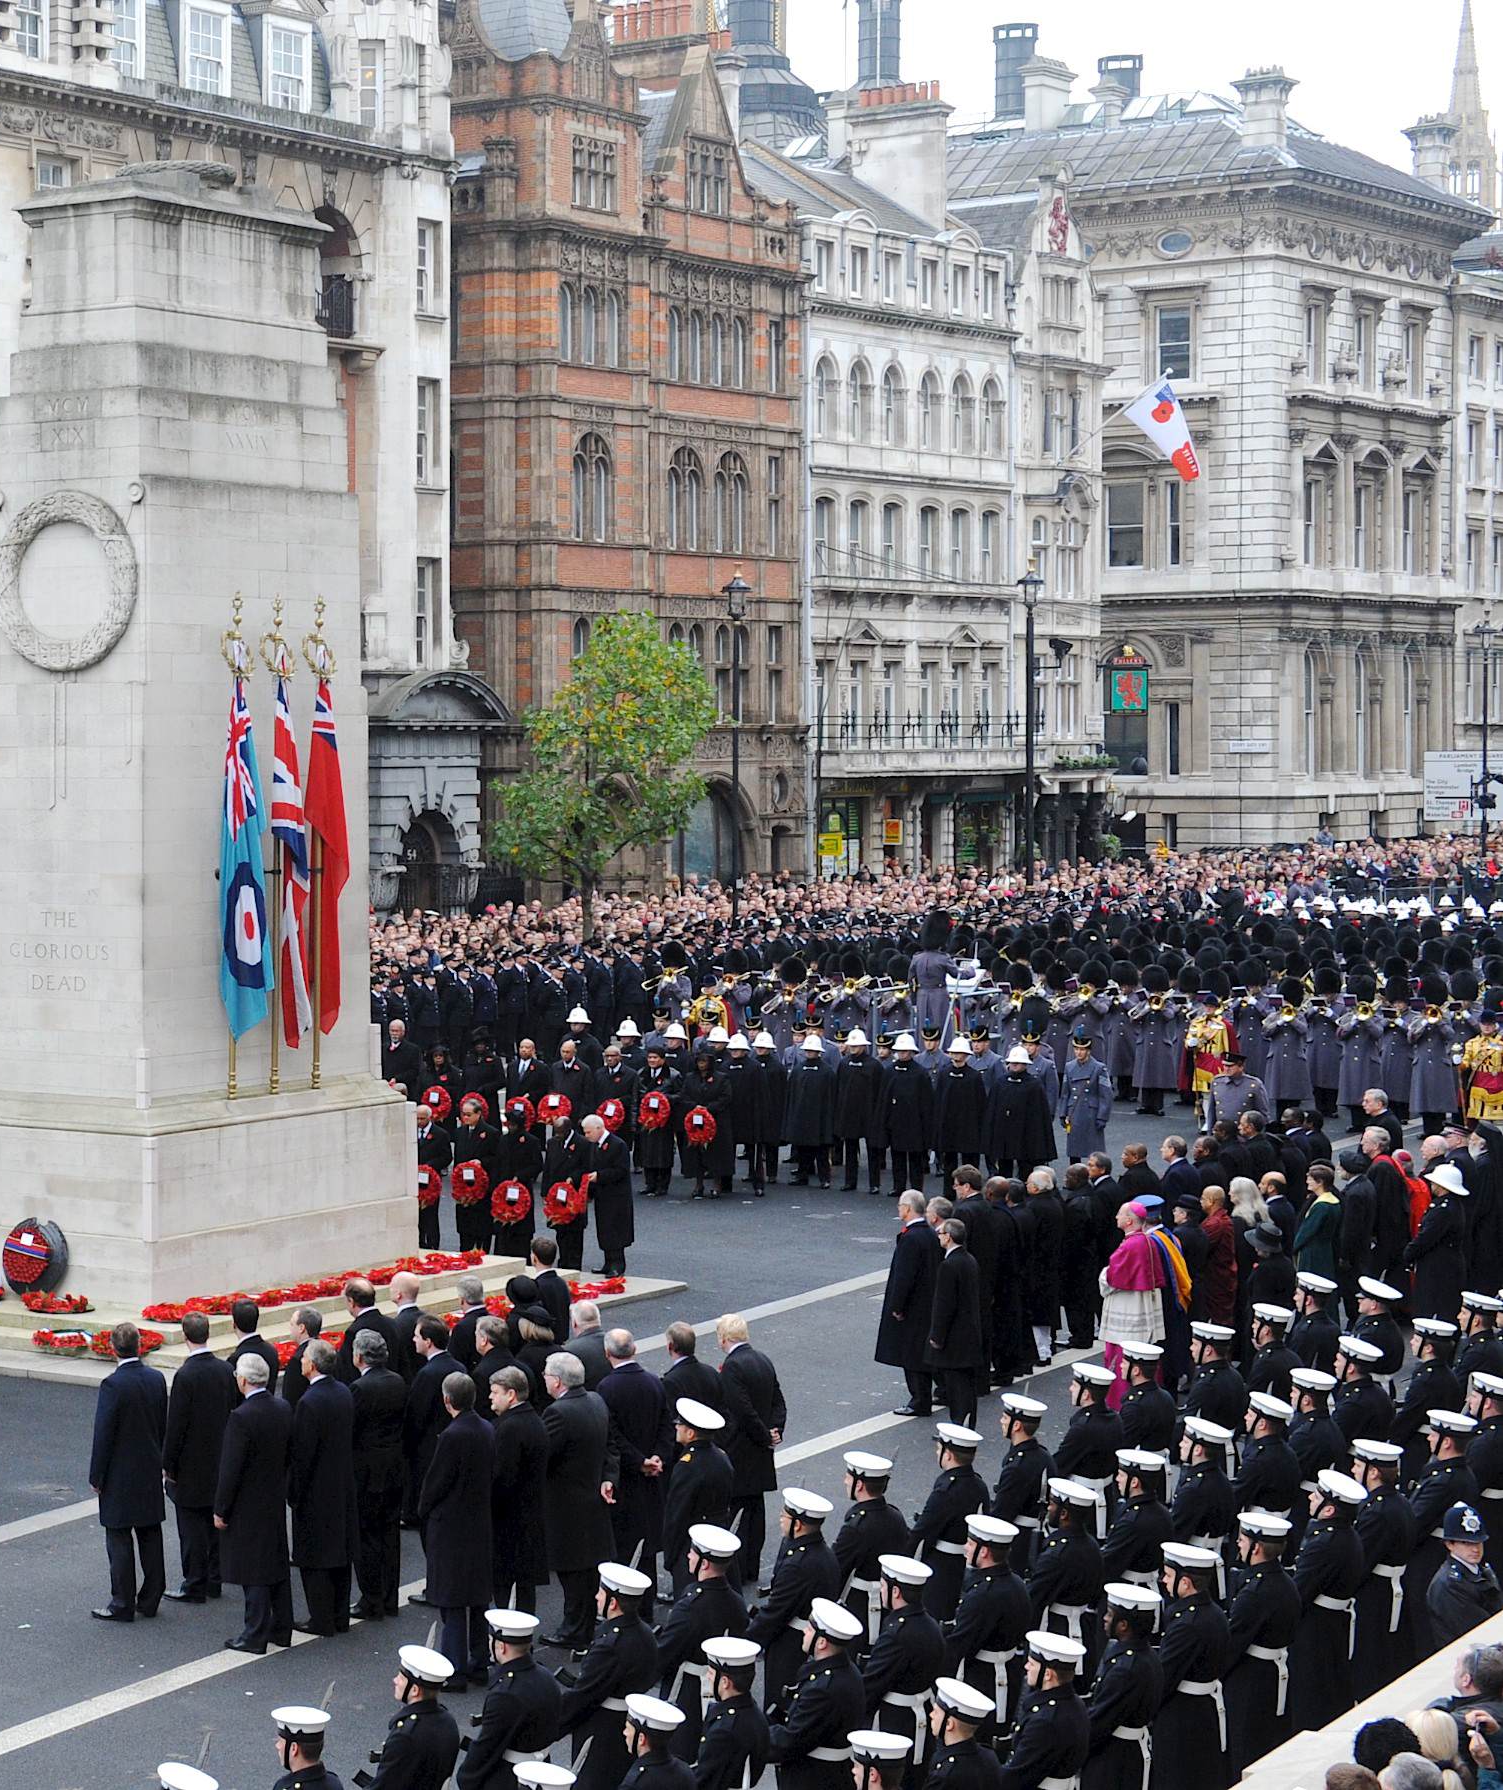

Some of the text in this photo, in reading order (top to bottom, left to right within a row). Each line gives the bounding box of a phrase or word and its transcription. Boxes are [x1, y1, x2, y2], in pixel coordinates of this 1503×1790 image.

[48, 396, 90, 416] MCM
[51, 426, 84, 446] XIX
[407, 848, 417, 861] 54
[40, 911, 78, 928] THE
[9, 942, 110, 961] GLORIOUS
[31, 974, 87, 992] DEAD
